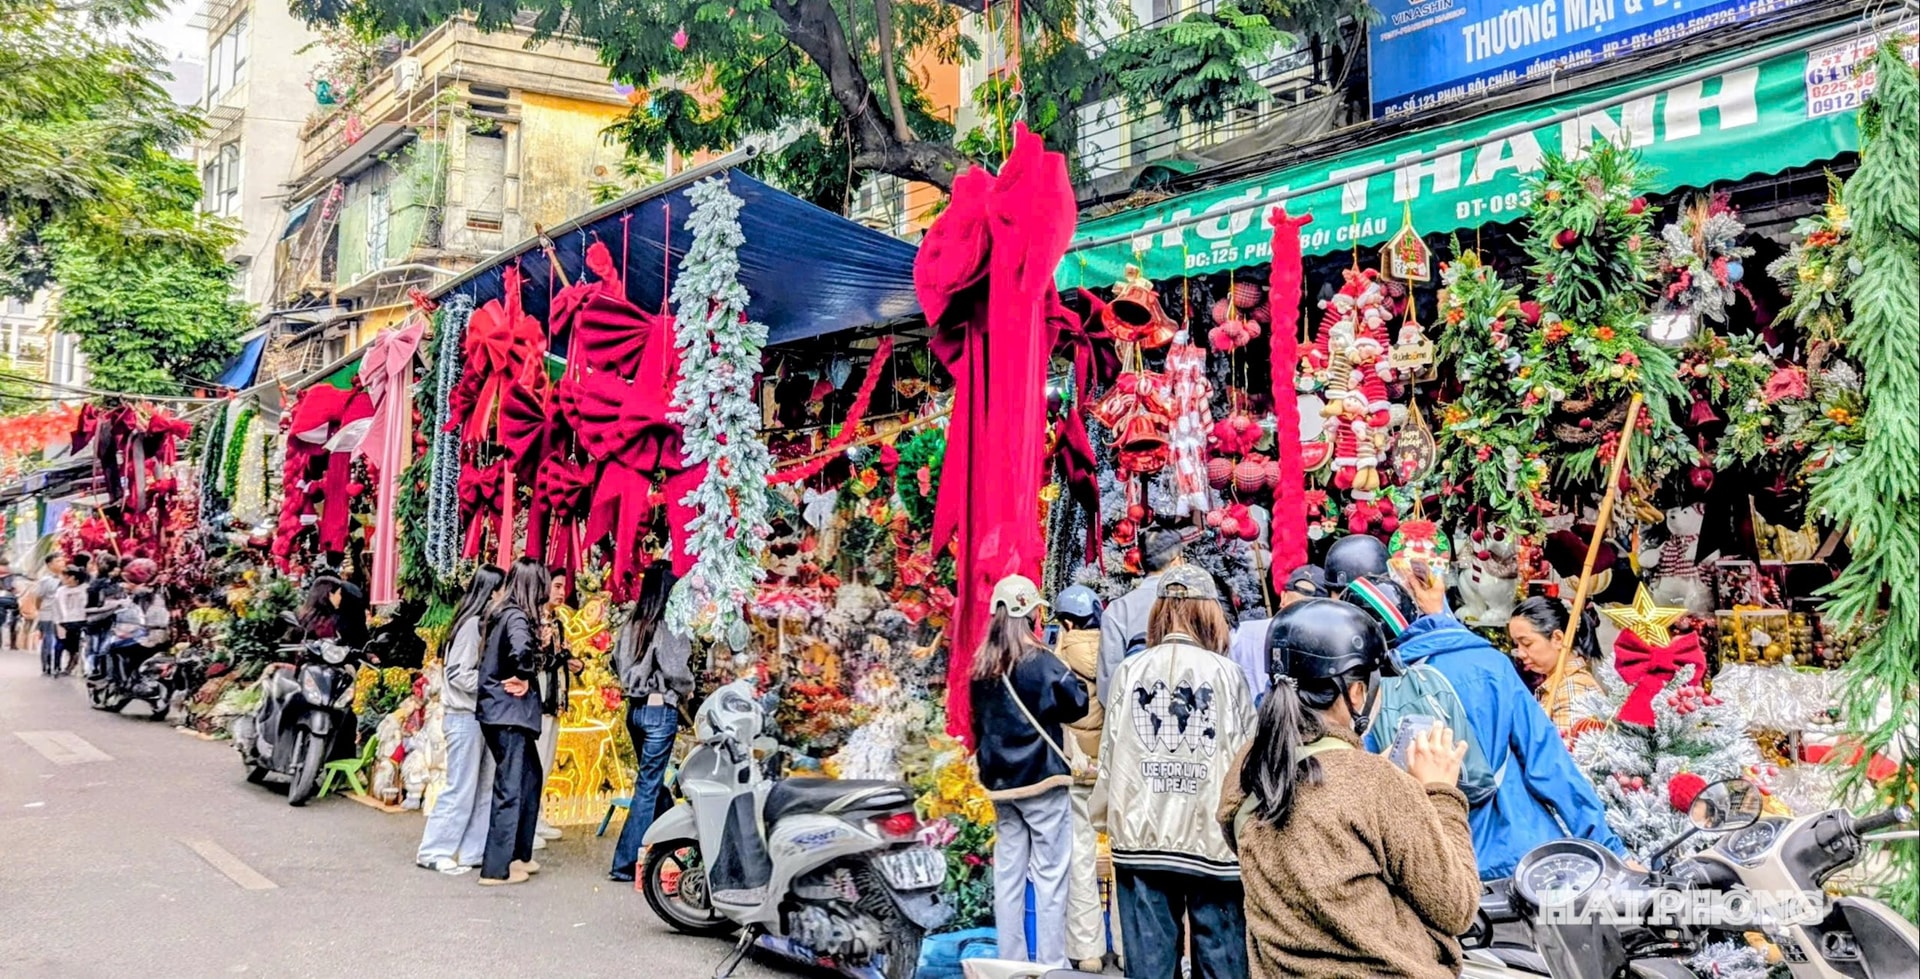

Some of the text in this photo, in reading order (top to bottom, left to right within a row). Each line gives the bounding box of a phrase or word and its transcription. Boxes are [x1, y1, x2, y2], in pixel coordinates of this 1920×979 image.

[1391, 0, 1453, 25] VINASHIN
[1462, 0, 1557, 63] THƯƠNG
[1808, 63, 1856, 85] 64 TR
[1811, 71, 1876, 98] 0225.38
[1812, 88, 1873, 114] 0912.6
[1328, 66, 1759, 215] THANH
[1456, 189, 1537, 220] ĐT-093
[1244, 241, 1273, 259] PH
[1300, 228, 1330, 250] BỘI
[1336, 217, 1387, 242] CHÂU
[1141, 761, 1159, 777] USE
[1159, 761, 1182, 777] FOR
[1153, 777, 1165, 793] IN
